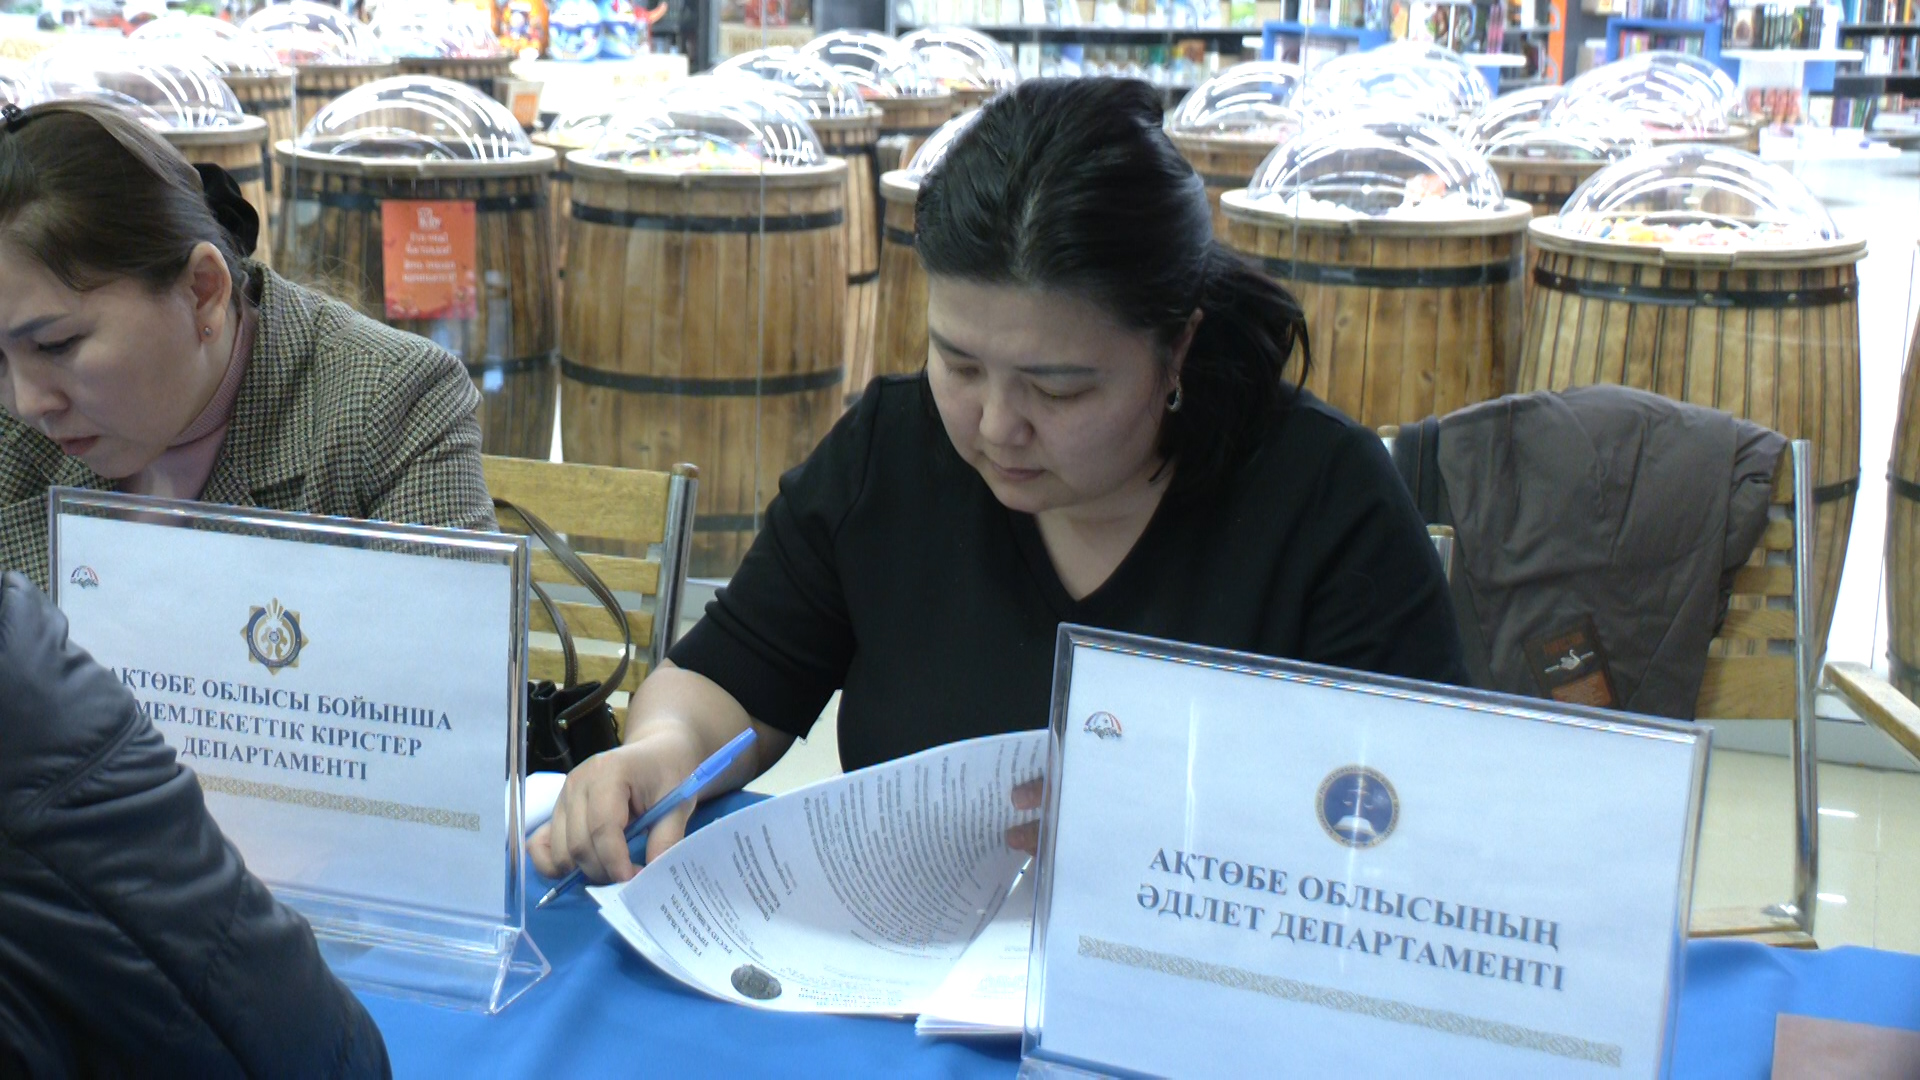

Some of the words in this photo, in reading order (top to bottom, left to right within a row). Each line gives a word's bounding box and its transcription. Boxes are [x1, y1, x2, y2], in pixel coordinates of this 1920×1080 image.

[202, 678, 310, 712] ОБЛЫСЫ
[317, 695, 452, 731] БОЙЫНША
[181, 736, 367, 781] ДЕПАРТАМЕНТІ
[311, 724, 422, 758] КІРІСТЕР
[1149, 847, 1288, 895] АҚТӨБЕ
[1298, 874, 1560, 953] ОБЛЫСЫНЫҢ
[1136, 882, 1265, 932] ӘДІЛЕТ
[1271, 910, 1566, 992] ДЕПАРТАМЕНТІ
